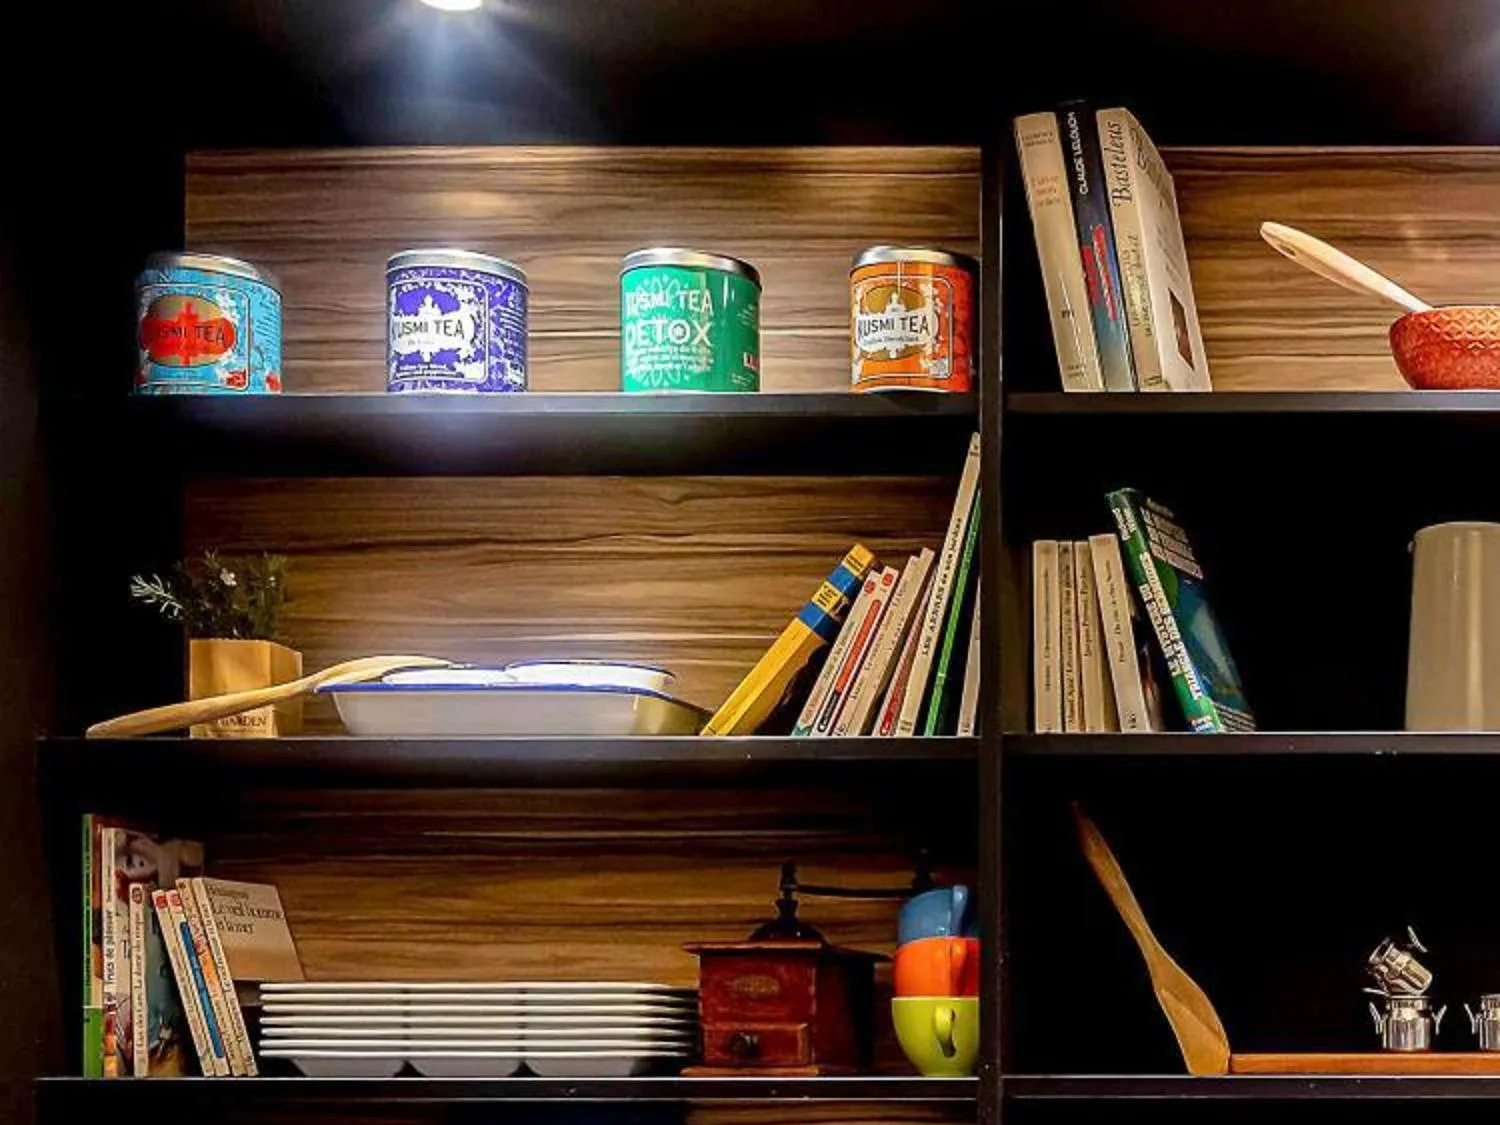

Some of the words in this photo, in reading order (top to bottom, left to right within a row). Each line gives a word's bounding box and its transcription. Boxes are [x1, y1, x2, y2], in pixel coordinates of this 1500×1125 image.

[676, 289, 714, 316] TEA
[195, 323, 225, 345] TEA
[434, 319, 464, 339] TEA
[625, 319, 713, 349] DETOX
[900, 315, 930, 336] TEA
